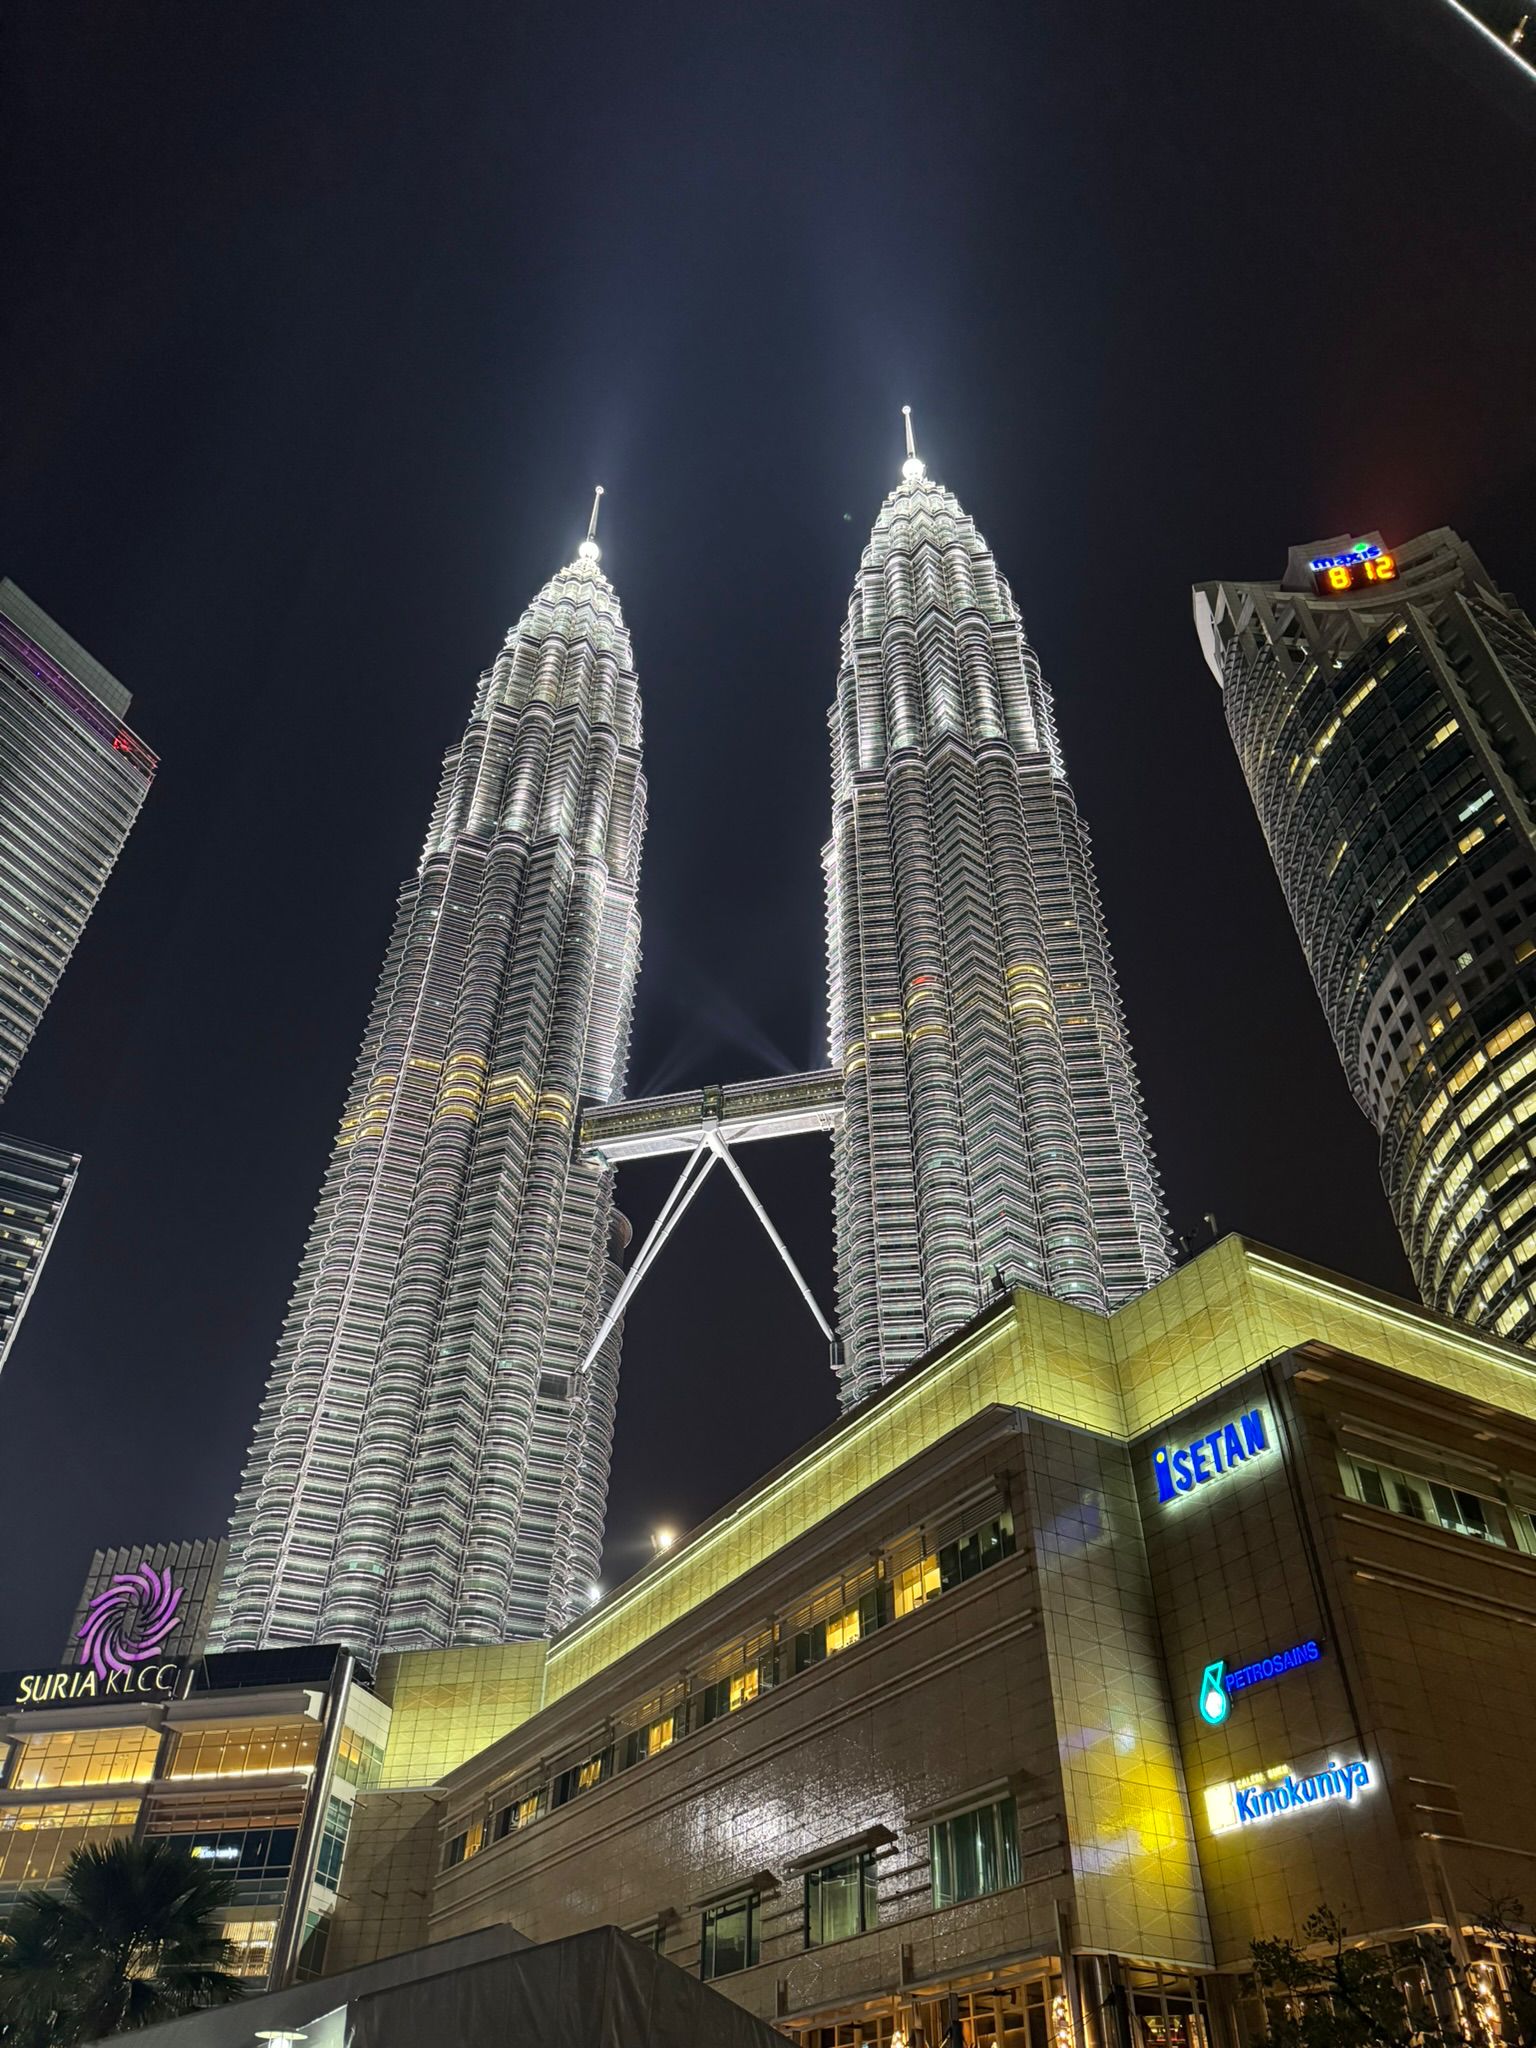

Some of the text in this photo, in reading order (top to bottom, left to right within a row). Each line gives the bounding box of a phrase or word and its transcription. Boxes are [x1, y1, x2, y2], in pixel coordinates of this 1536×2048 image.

[1310, 544, 1382, 570] maxis
[16, 1664, 178, 1702] SURIA KLCC
[1224, 1640, 1320, 1692] PETROSAINS
[1235, 1760, 1370, 1822] Kinokuniya
